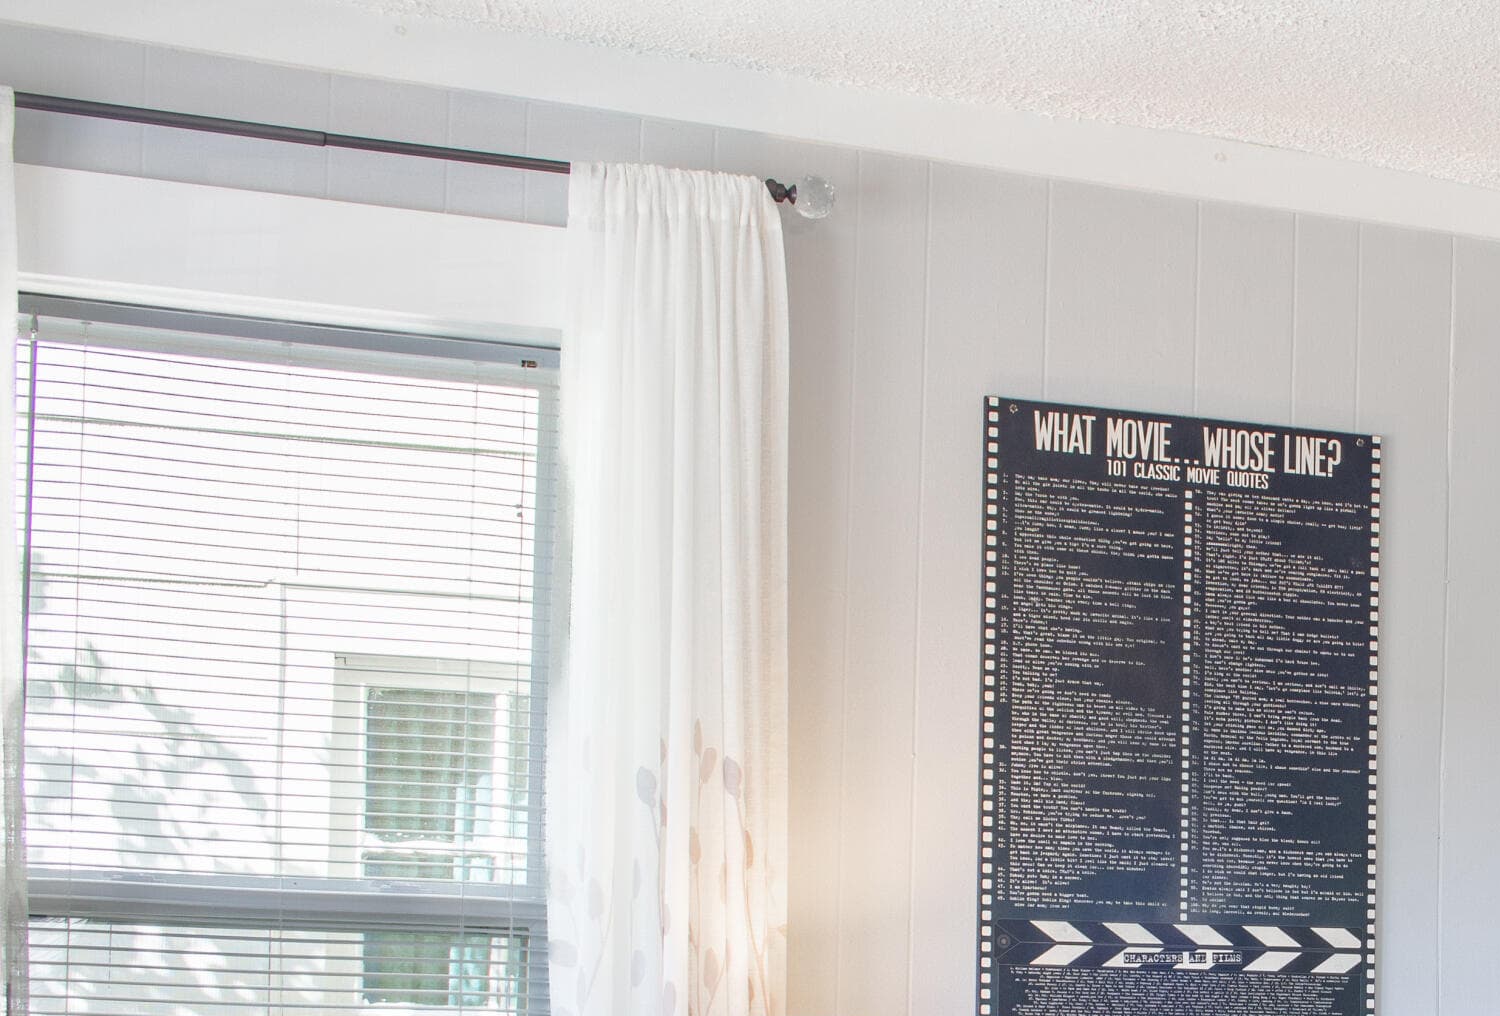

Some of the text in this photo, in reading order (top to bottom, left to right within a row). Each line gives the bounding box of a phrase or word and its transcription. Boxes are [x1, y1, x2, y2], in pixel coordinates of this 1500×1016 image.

[1034, 410, 1096, 455] WHAT
[1283, 434, 1342, 478] LINE?
[1106, 459, 1269, 490] 101 CLASSIC MOVIE QUOTES
[1123, 952, 1183, 964] CHARACTERS
[1212, 952, 1242, 964] FILMS
